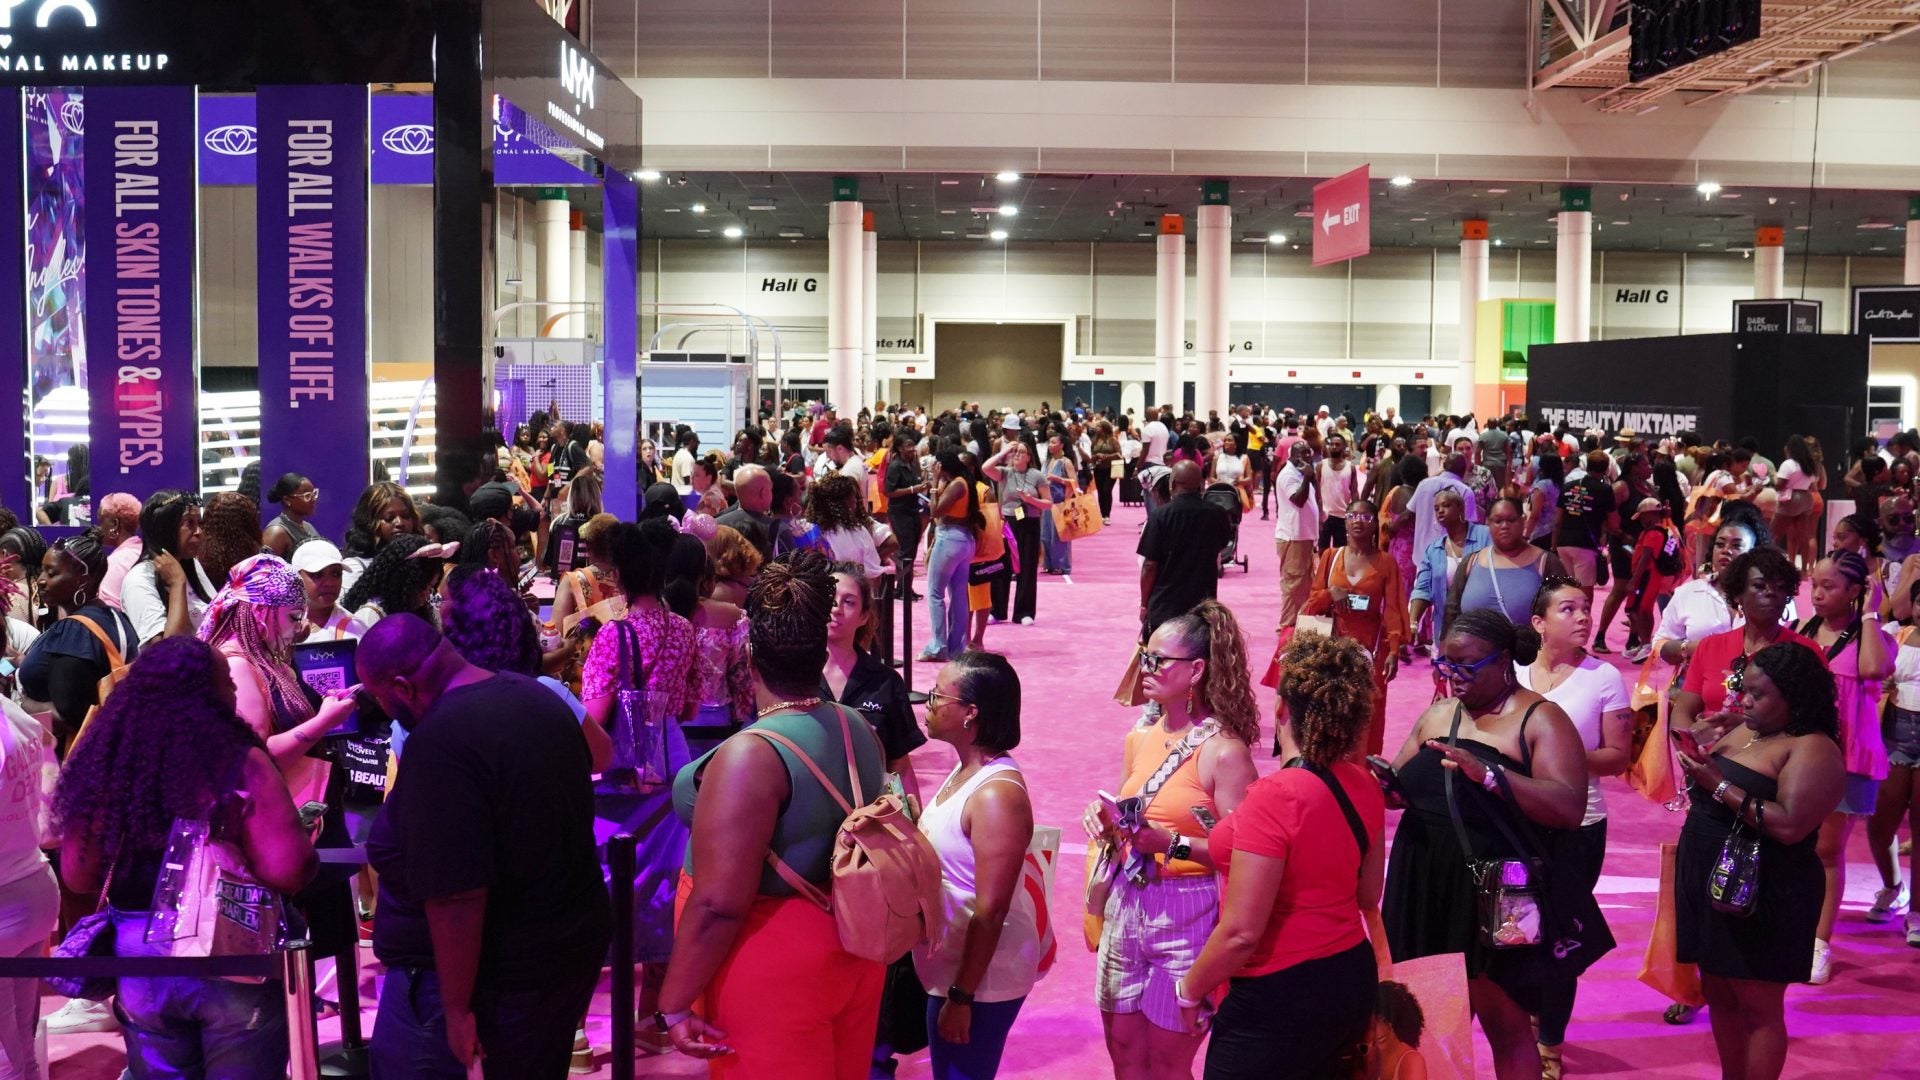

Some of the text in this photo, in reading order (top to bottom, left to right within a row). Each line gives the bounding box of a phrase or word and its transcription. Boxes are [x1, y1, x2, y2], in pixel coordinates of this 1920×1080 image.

[61, 54, 169, 71] MAKEUP
[561, 40, 595, 110] NYX
[1343, 202, 1361, 226] EXIT
[288, 119, 334, 408] FOR ALL WALKS OF LIFE.
[804, 278, 818, 292] G
[114, 120, 164, 474] FOR ALL SKIN TONES & TYPES.
[1615, 289, 1669, 303] Hall G
[1746, 316, 1767, 325] DARK
[1753, 323, 1779, 333] LOVELY
[896, 338, 916, 348] 11A
[1243, 341, 1253, 350] G
[1541, 408, 1697, 436] THE BEAUTY MIXTAPE
[309, 652, 335, 662] NYX
